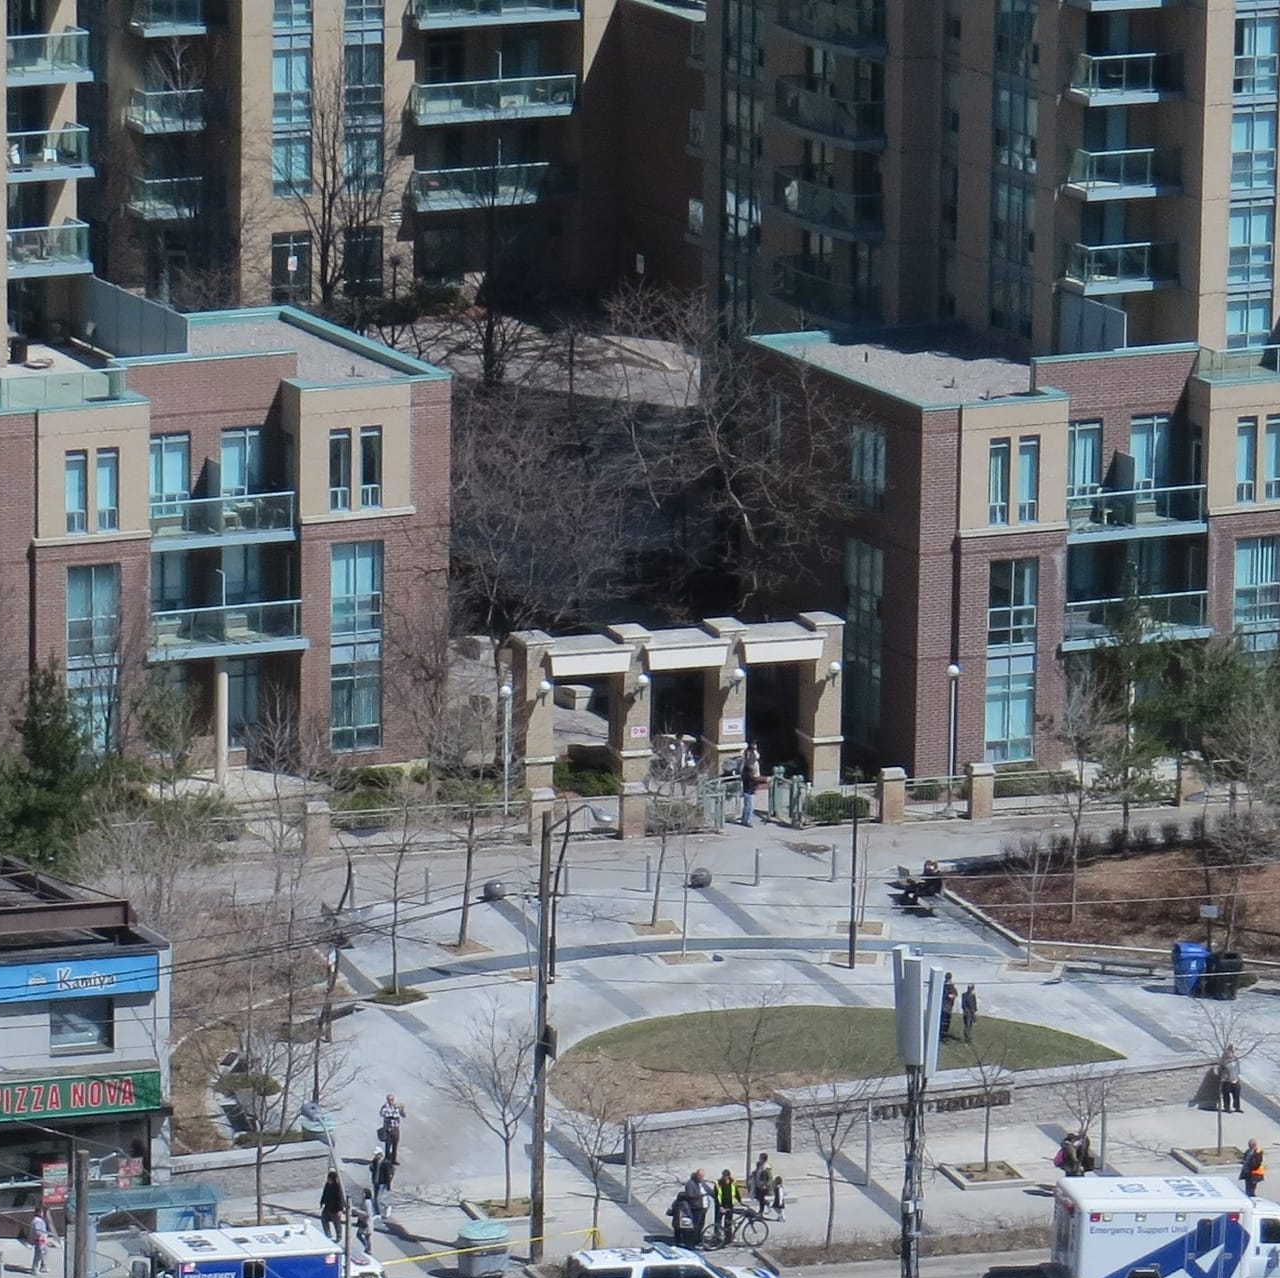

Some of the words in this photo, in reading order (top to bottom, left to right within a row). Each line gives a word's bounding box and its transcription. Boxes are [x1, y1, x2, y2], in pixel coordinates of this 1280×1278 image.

[56, 967, 116, 991] Kamiya
[72, 1079, 137, 1107] NOVA
[1089, 1225, 1135, 1236] Emergency
[1136, 1224, 1177, 1235] Support
